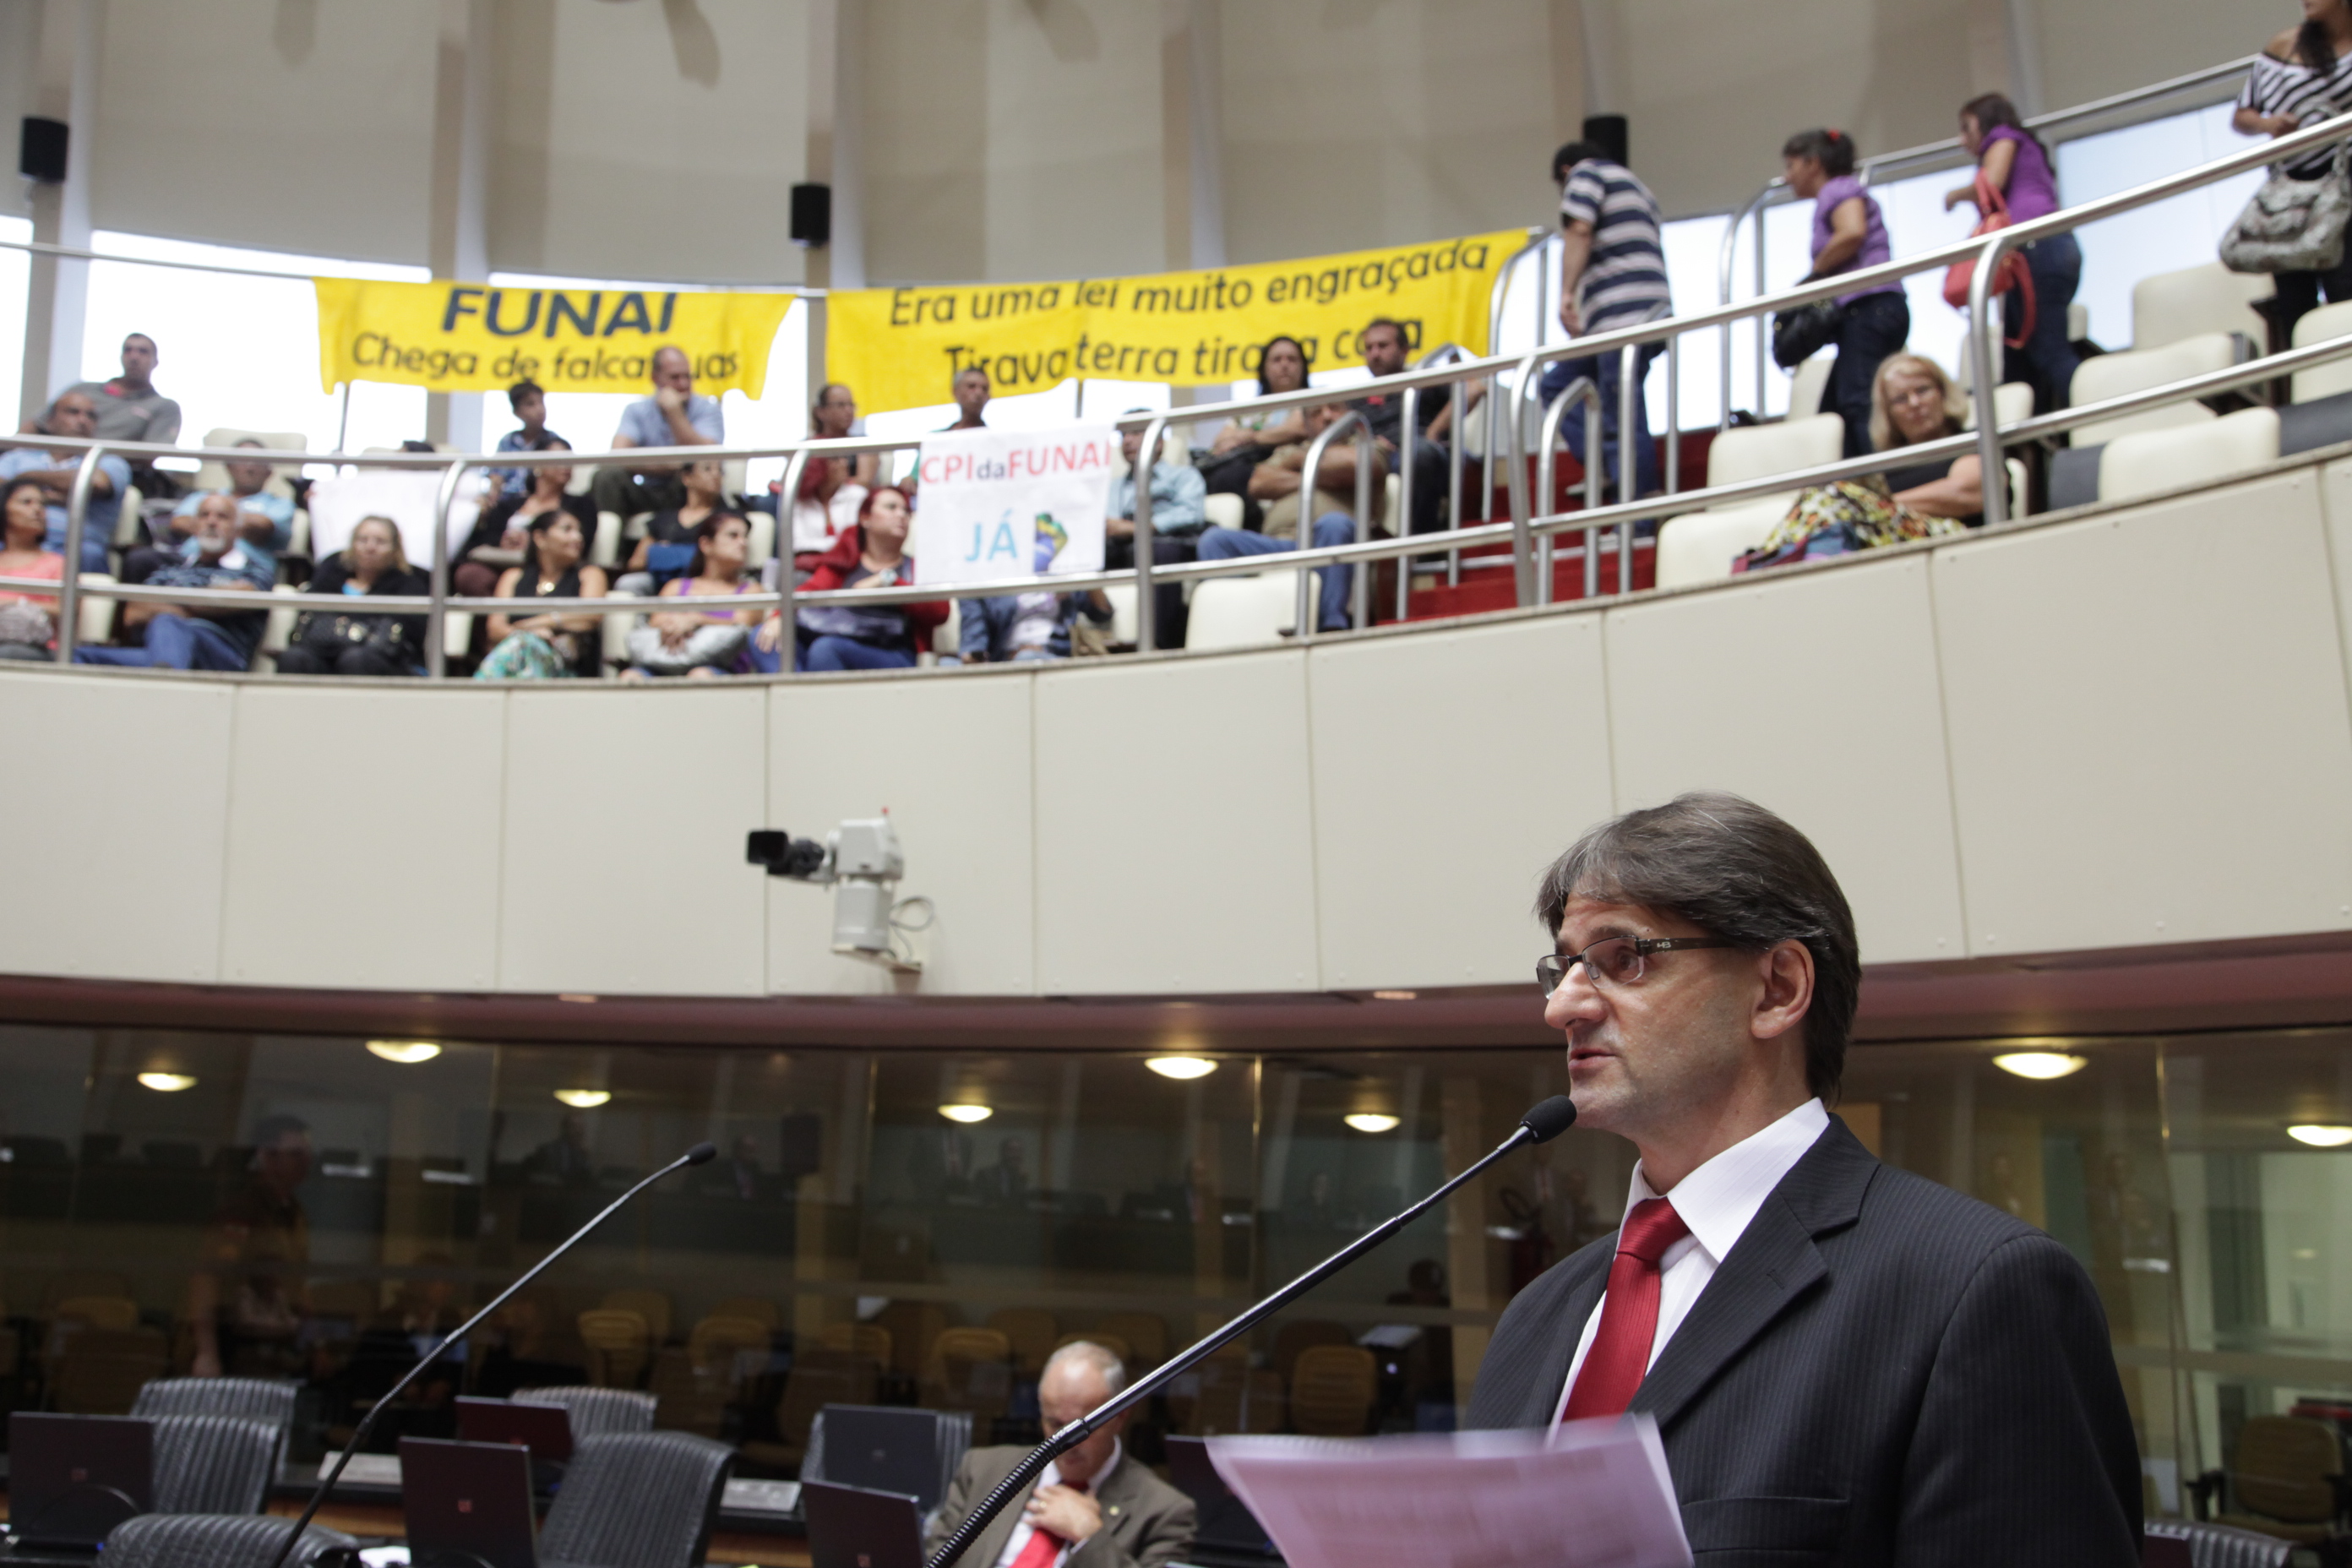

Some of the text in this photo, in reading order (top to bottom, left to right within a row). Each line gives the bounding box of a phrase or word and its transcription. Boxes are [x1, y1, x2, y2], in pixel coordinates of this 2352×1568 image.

[890, 238, 1489, 326] Era uma lei muito engraçada
[442, 288, 678, 338] FUNAI
[351, 331, 478, 380] Chega
[493, 346, 539, 379] de
[1075, 332, 1179, 376] terra
[965, 509, 1018, 561] JÁ
